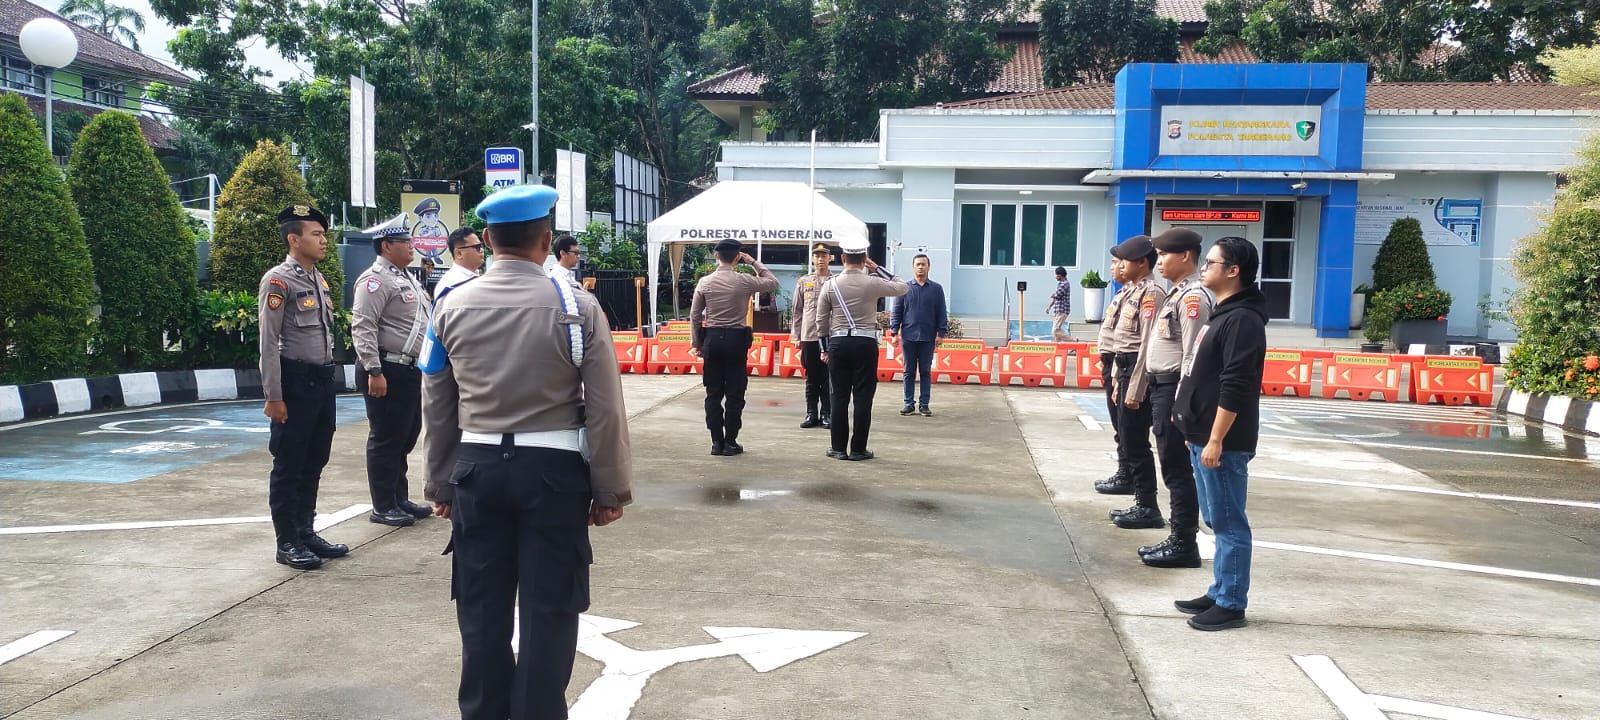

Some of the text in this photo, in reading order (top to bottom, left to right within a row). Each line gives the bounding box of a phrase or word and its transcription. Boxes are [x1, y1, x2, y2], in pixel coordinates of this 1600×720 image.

[1189, 120, 1291, 128] KLINIK BHAYANGKARA
[1187, 133, 1292, 141] POLRESTA TANGERANG
[500, 153, 515, 164] BRI
[493, 179, 515, 188] ATM
[680, 228, 833, 240] POLRESTA TANGERANG
